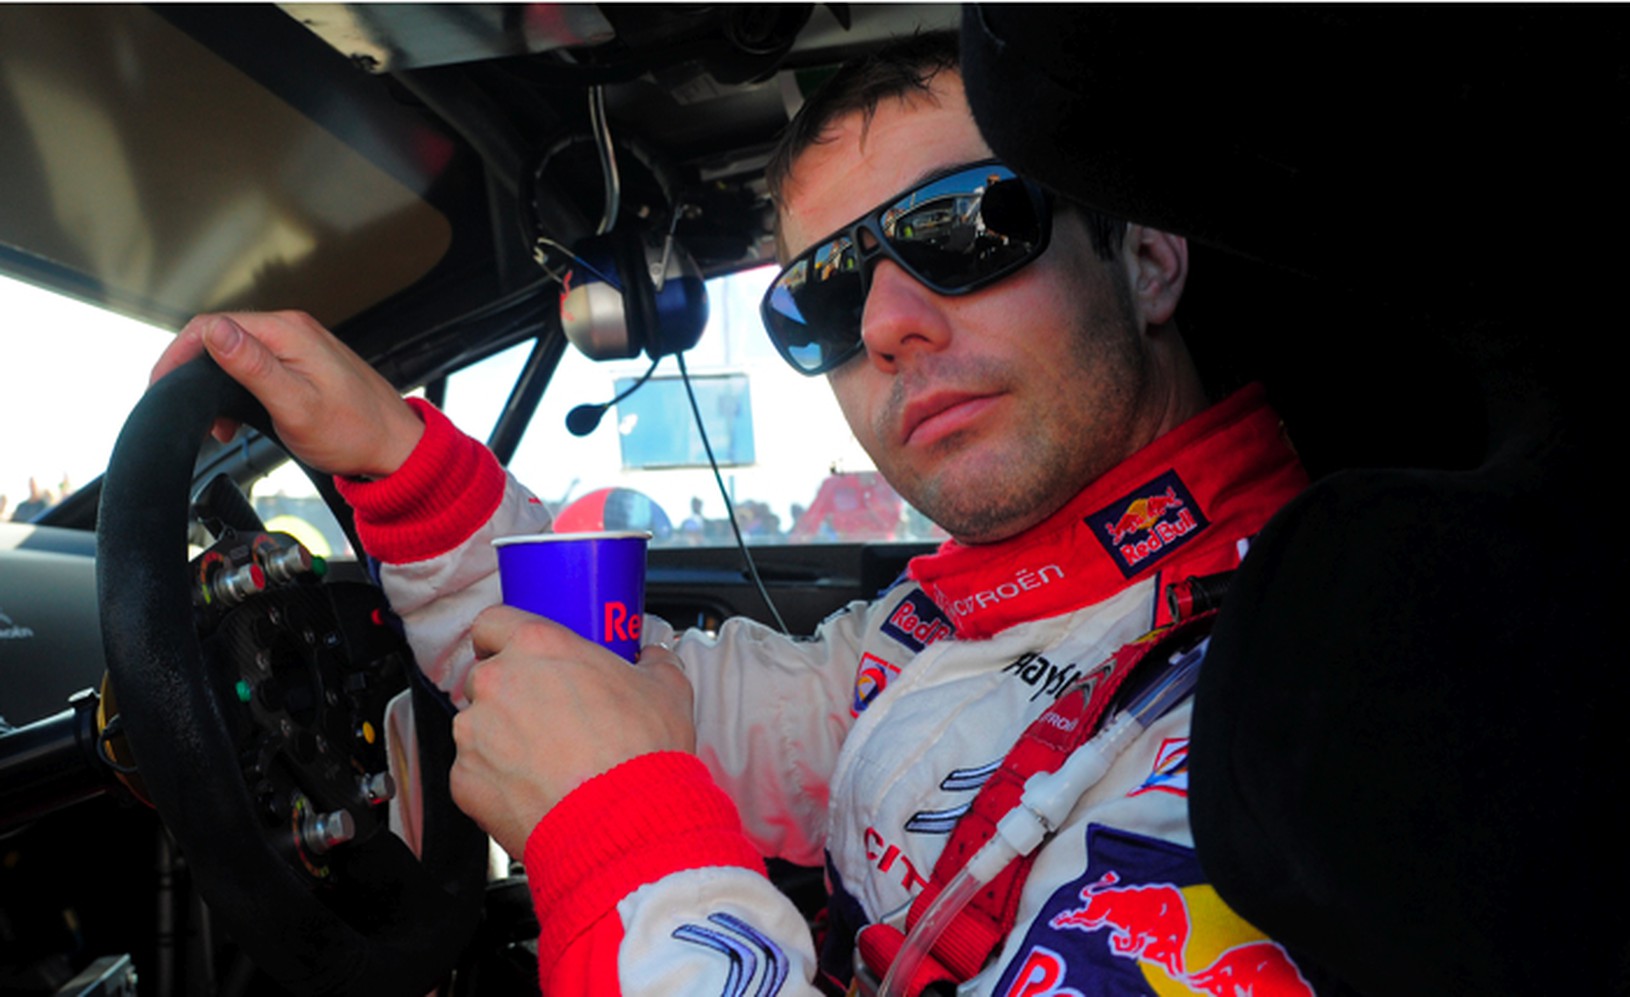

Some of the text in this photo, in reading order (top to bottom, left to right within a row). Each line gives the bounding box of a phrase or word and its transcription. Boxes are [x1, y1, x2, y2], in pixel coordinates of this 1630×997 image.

[1120, 507, 1198, 567] Red Bull
[888, 601, 941, 644] Red
